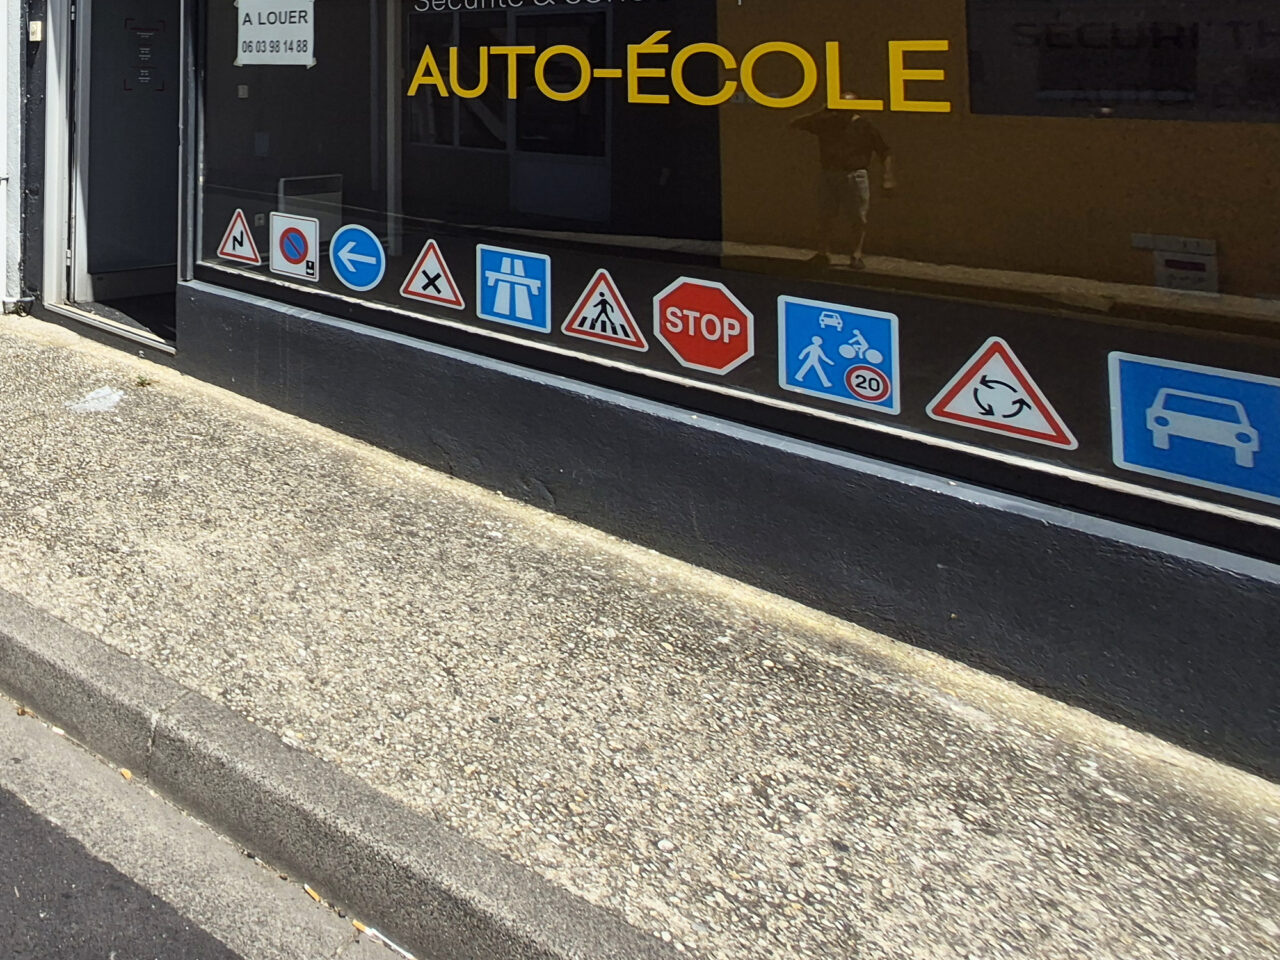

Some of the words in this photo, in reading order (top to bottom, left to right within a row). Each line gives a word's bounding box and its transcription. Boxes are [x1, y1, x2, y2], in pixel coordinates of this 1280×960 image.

[242, 12, 253, 26] A
[258, 10, 308, 25] LOUER
[241, 40, 253, 54] 06
[255, 40, 266, 54] 03
[283, 40, 294, 54] 14
[296, 40, 308, 54] 88
[407, 30, 952, 113] AUTO-ÉCOLE
[665, 305, 741, 344] STOP
[855, 374, 880, 392] 20
